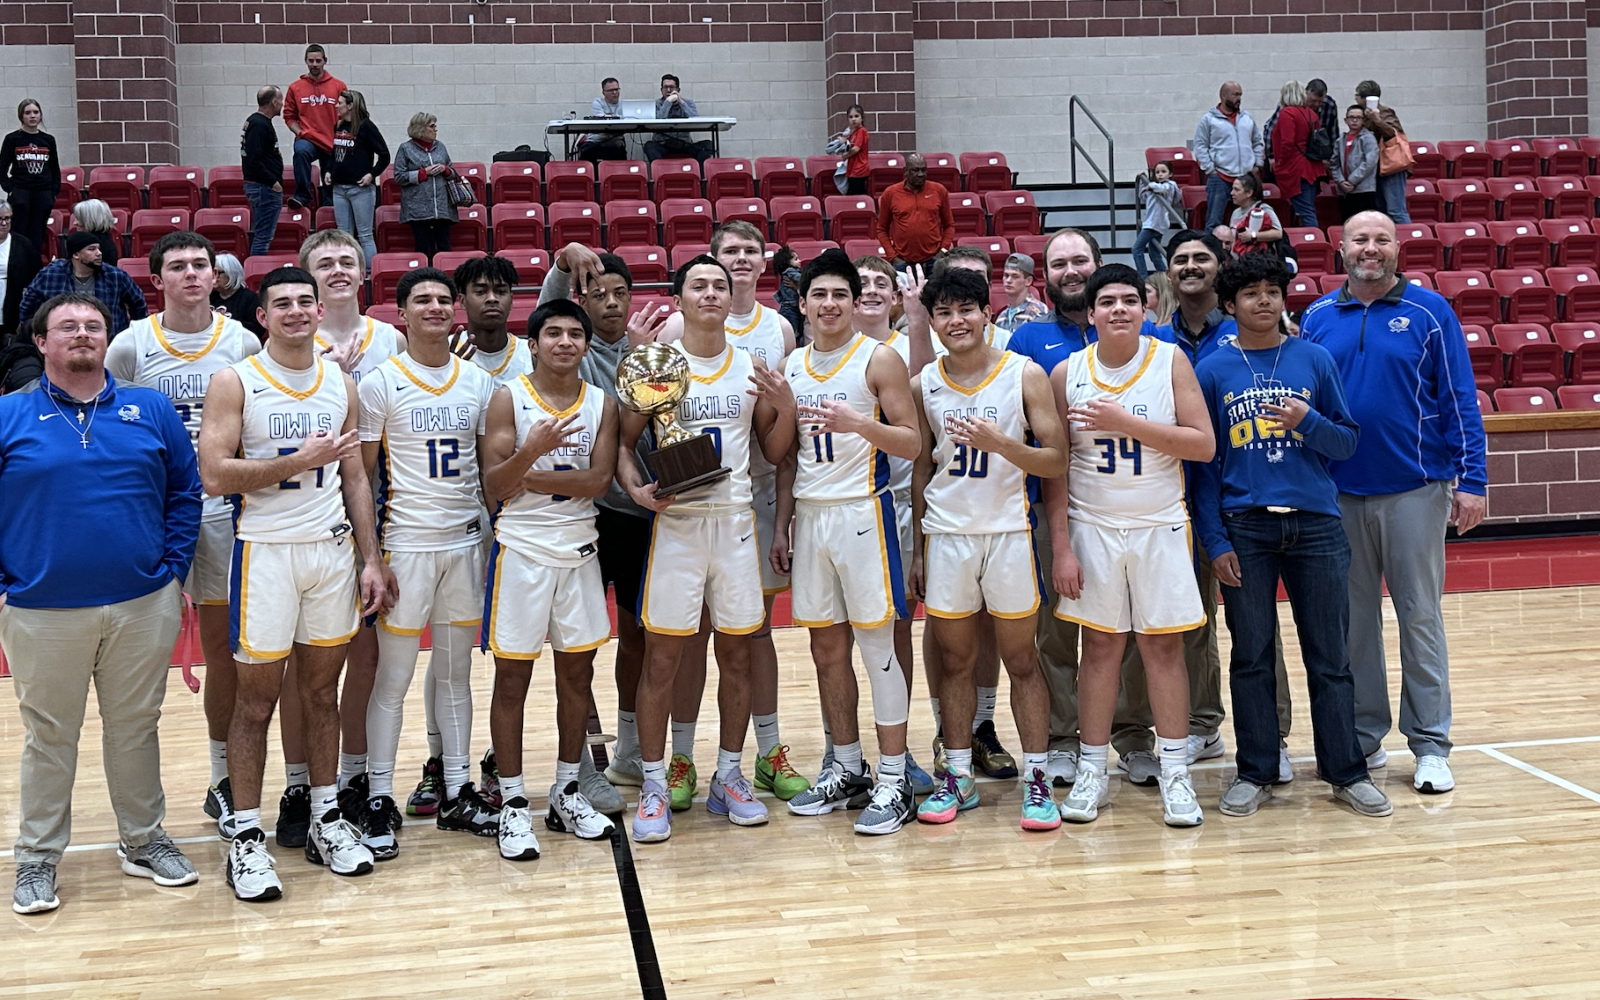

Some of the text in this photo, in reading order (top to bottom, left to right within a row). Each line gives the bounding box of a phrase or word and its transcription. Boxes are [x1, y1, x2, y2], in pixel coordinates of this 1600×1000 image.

[159, 373, 215, 400] OWL
[411, 406, 471, 432] OWLS
[679, 394, 741, 421] OWLS
[1228, 399, 1257, 419] STATE
[425, 438, 460, 478] 12
[811, 424, 835, 464] 11
[947, 441, 989, 478] 30
[1093, 437, 1142, 476] 34
